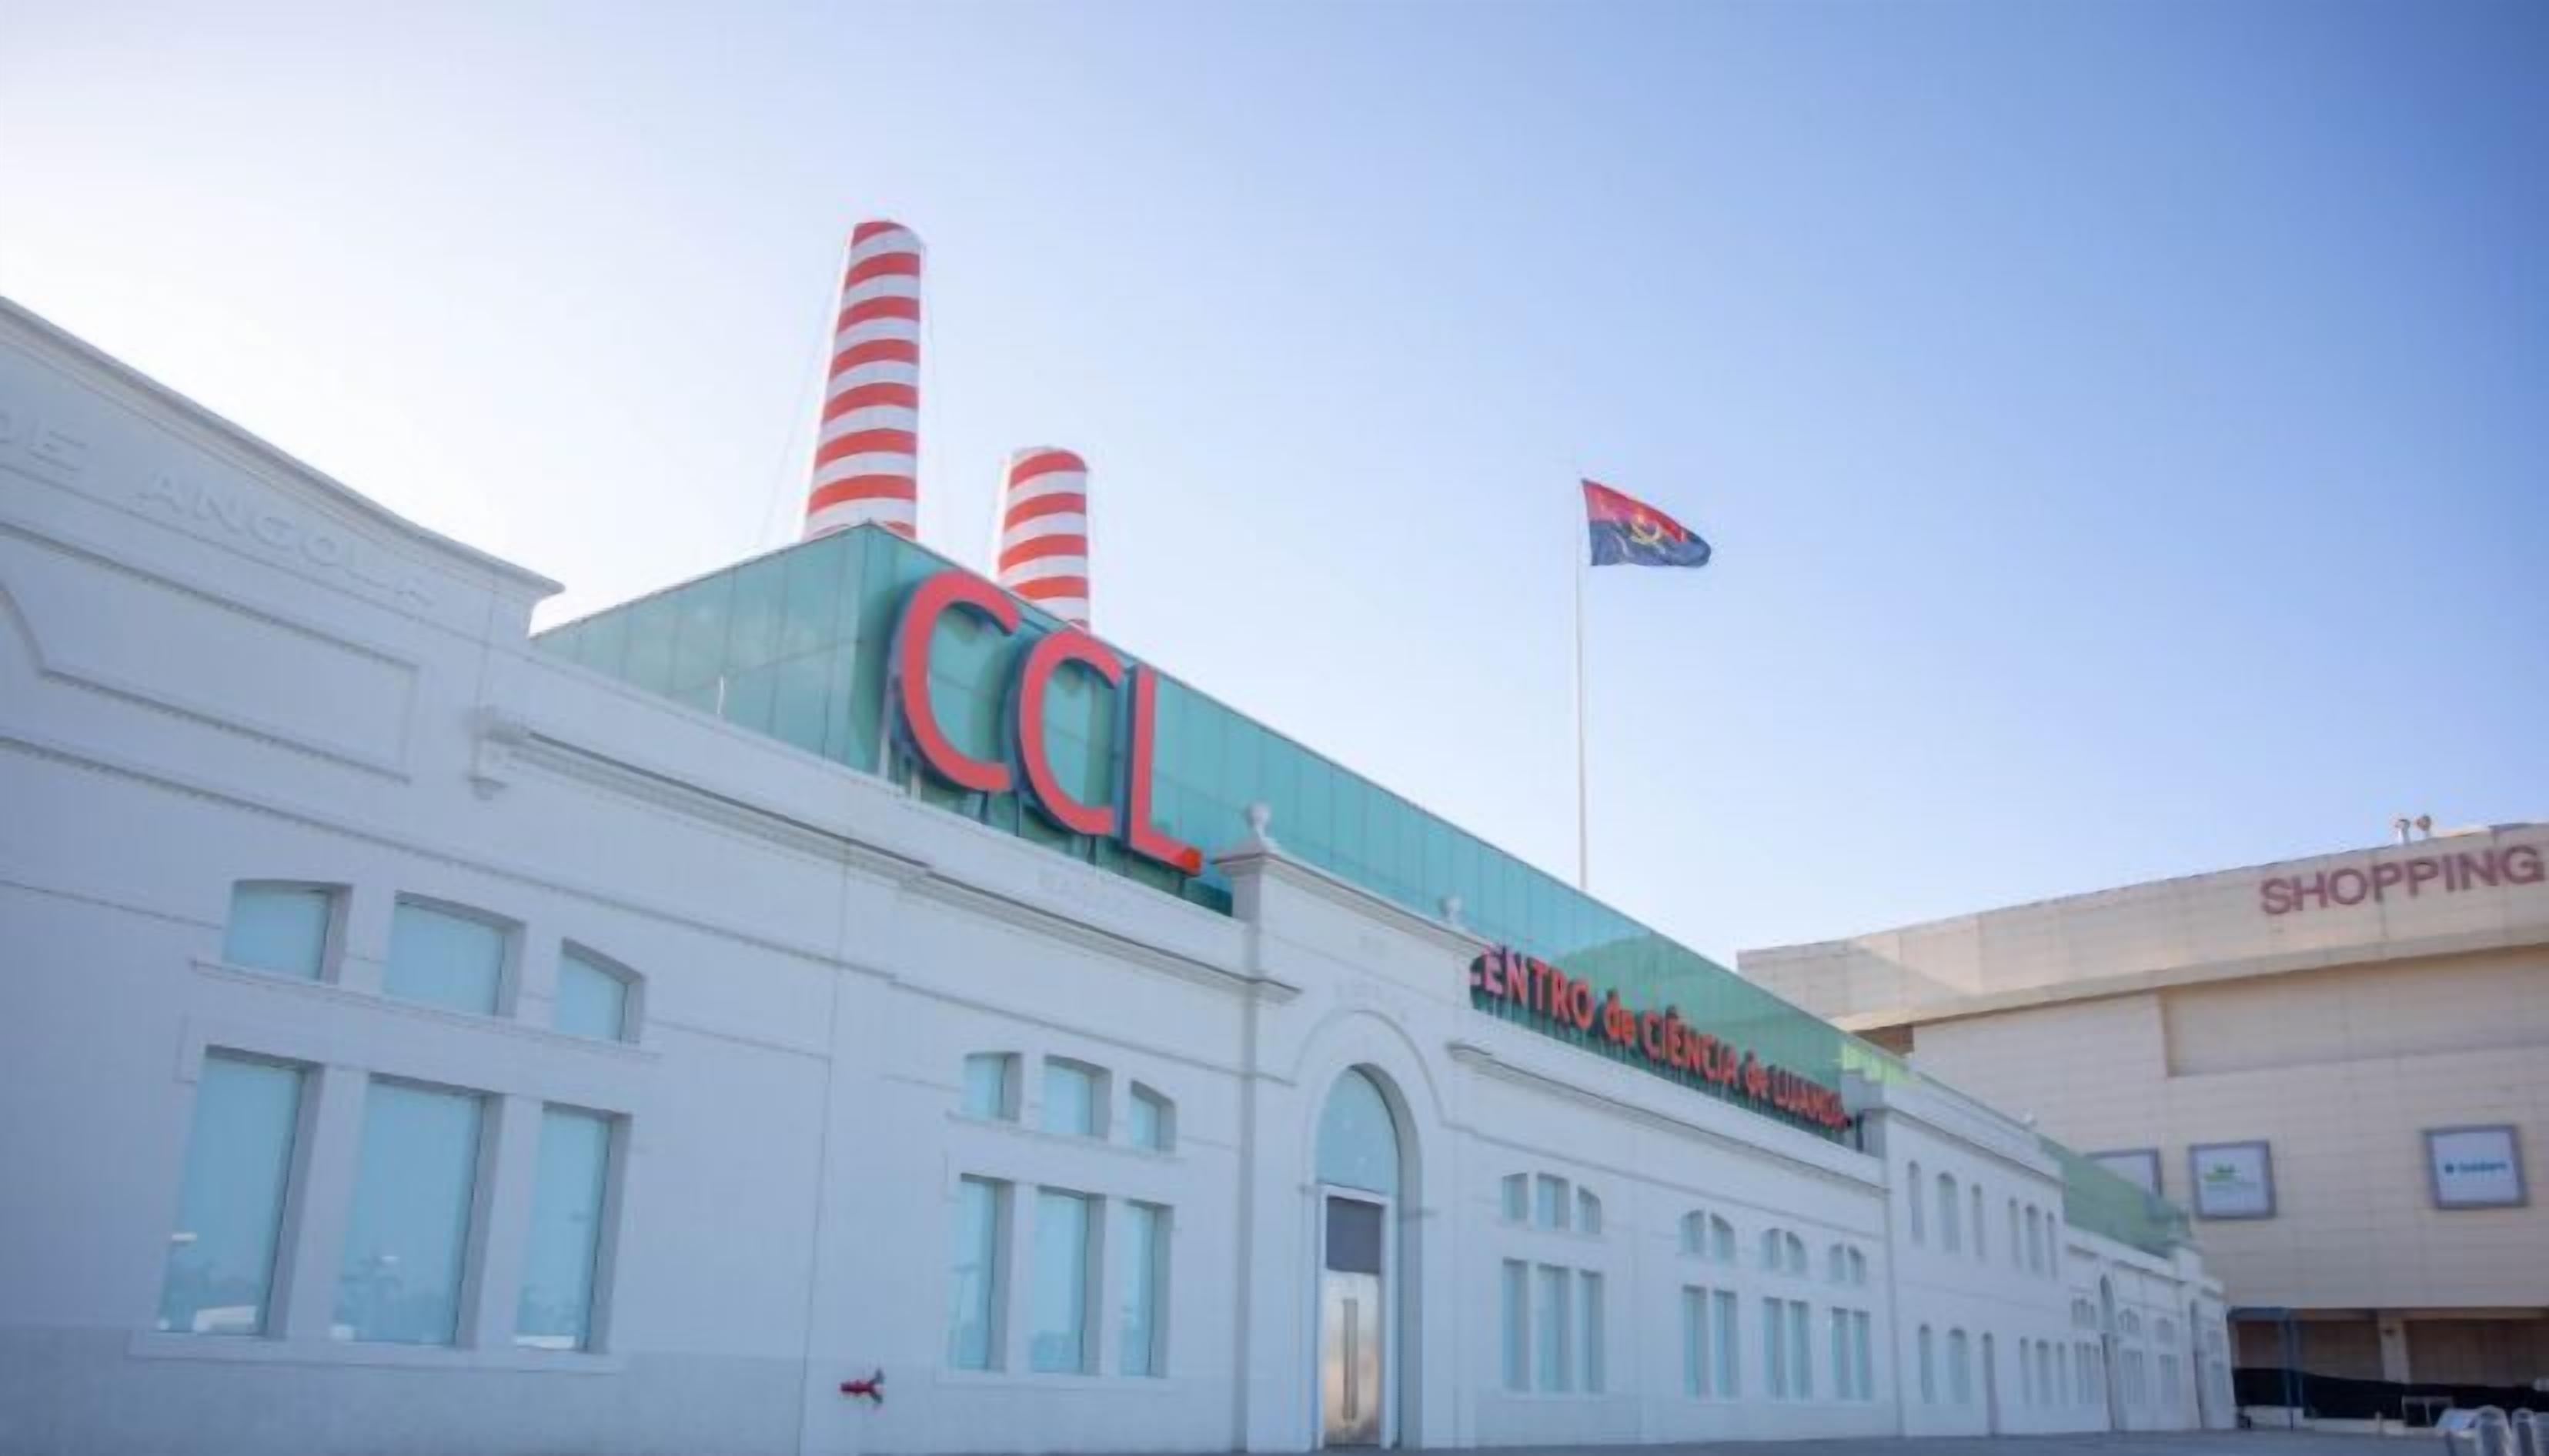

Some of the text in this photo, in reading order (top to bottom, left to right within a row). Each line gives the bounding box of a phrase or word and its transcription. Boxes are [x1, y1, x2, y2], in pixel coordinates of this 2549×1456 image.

[893, 568, 1202, 876] CCL
[2260, 845, 2545, 915] SHOPPING
[1604, 989, 1635, 1047] de
[1642, 1004, 1738, 1084] CIÊNCIA
